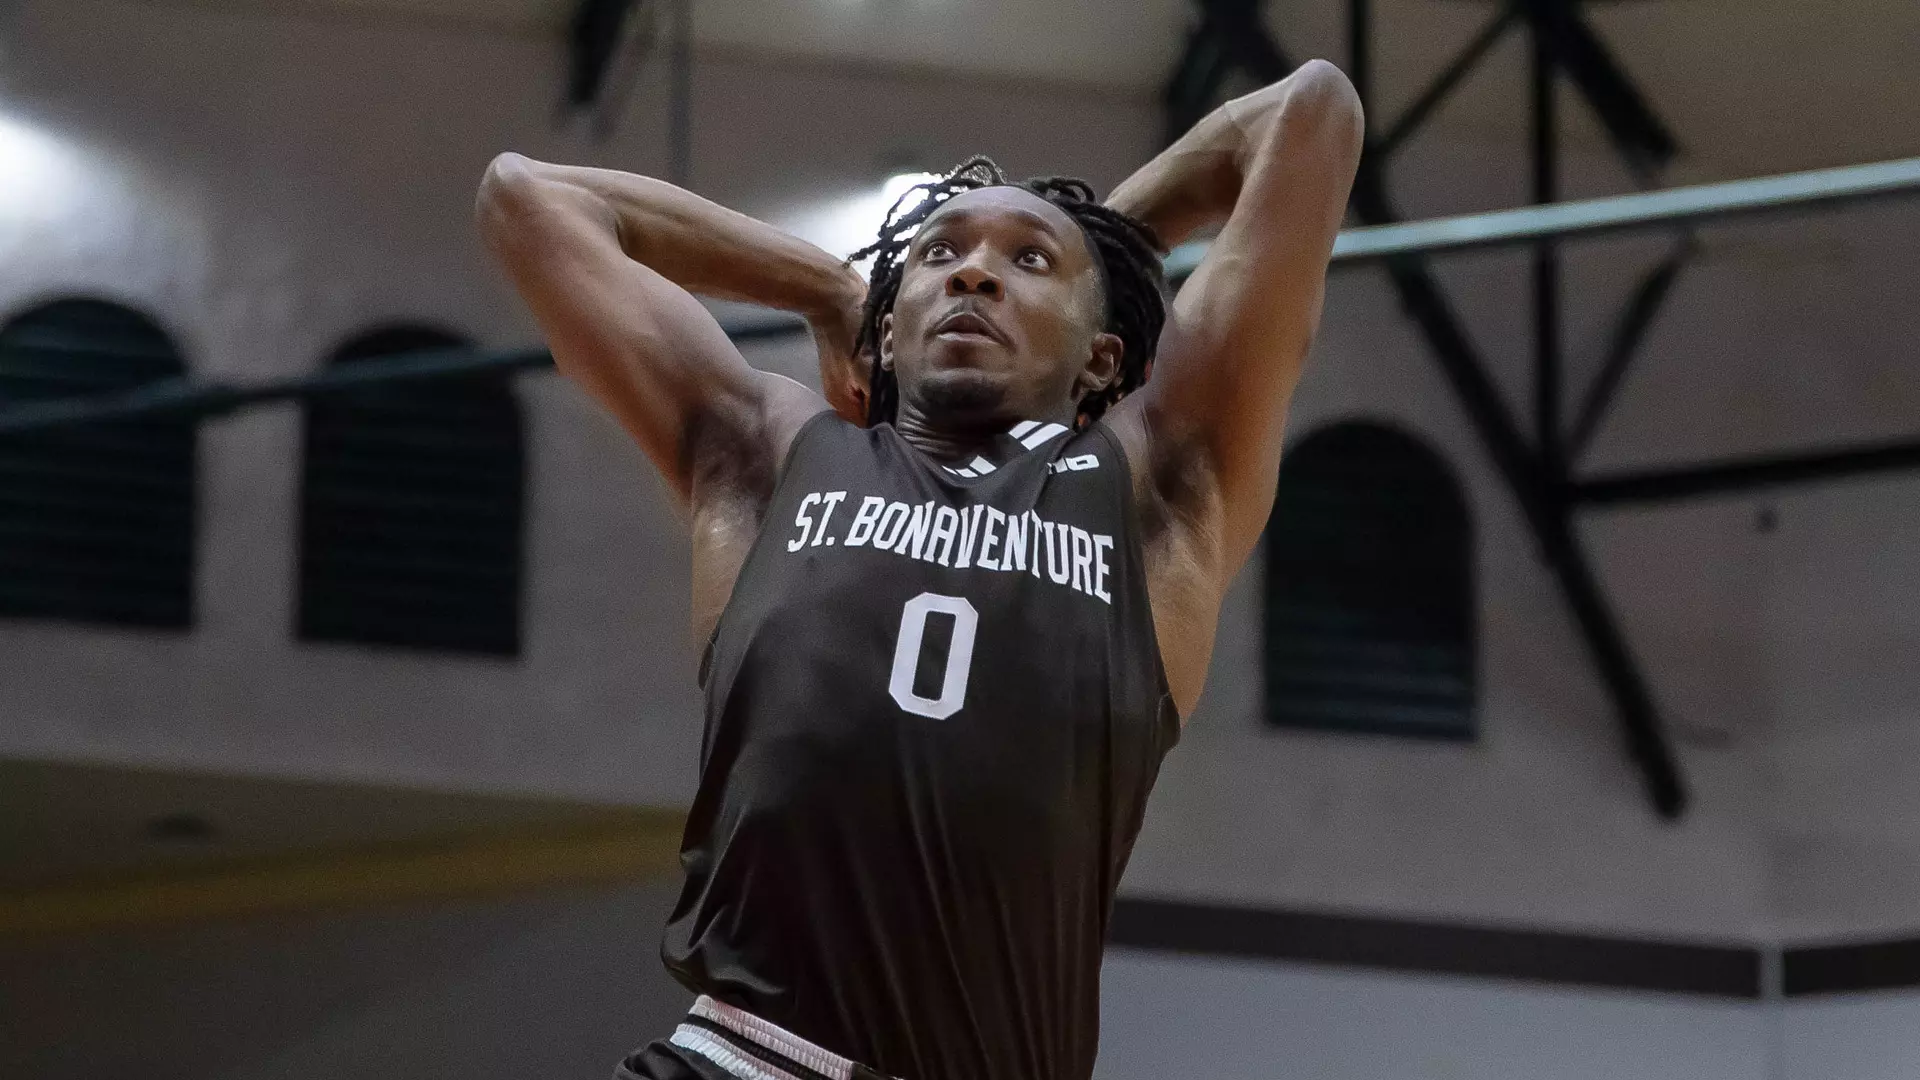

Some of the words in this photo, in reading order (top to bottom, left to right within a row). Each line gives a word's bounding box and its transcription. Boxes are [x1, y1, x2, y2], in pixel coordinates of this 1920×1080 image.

[787, 491, 848, 553] ST.
[844, 496, 1114, 604] BONAVENTURE
[888, 592, 979, 720] 0
